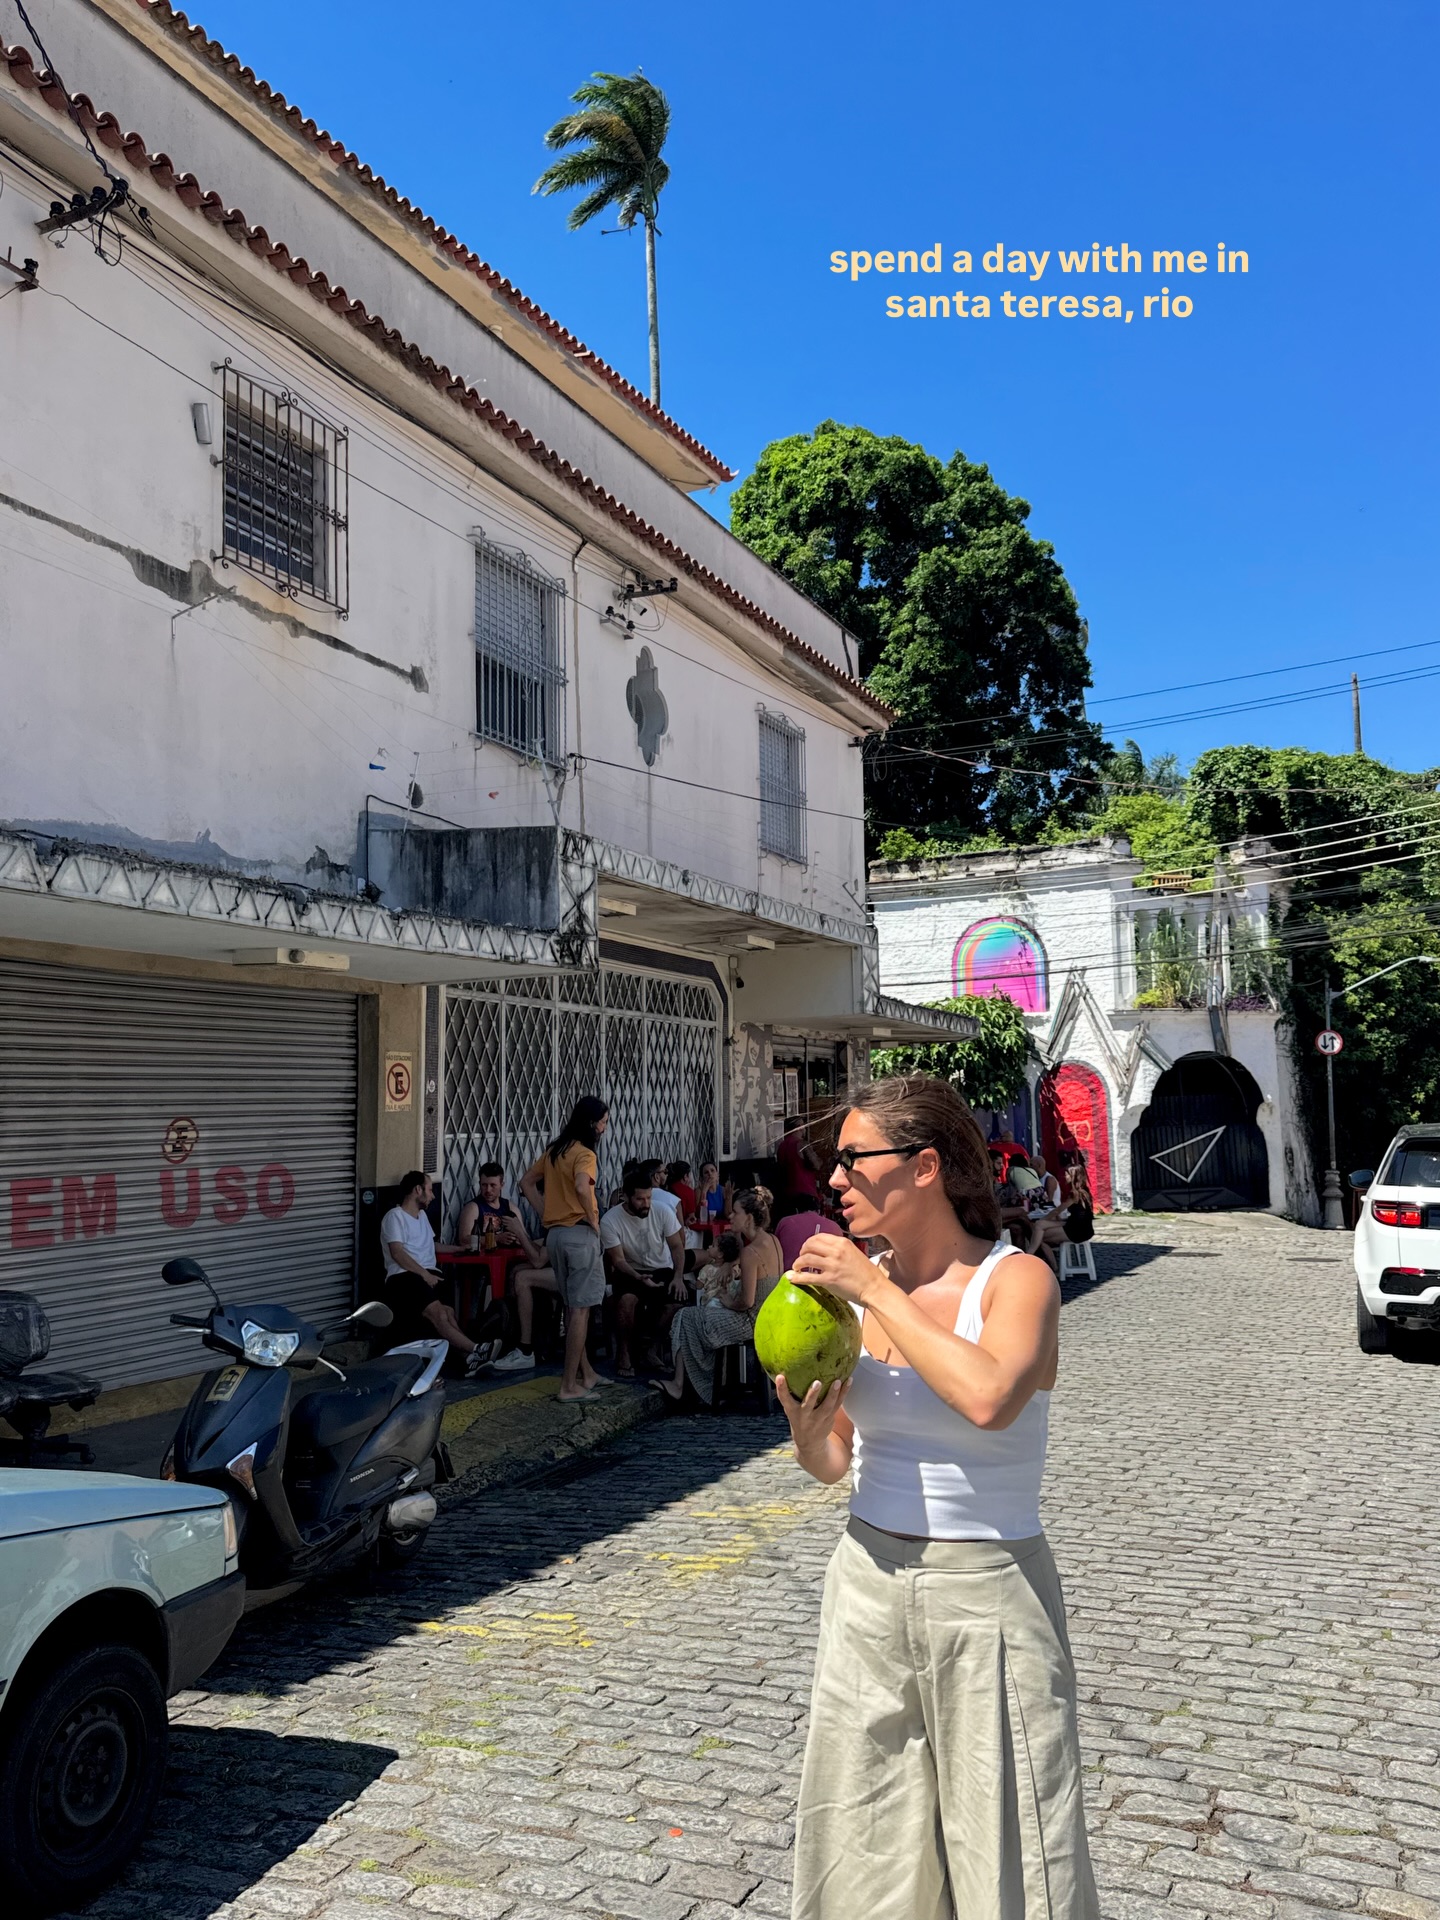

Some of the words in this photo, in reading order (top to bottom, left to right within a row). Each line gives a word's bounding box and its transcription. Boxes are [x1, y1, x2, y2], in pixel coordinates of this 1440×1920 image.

[10, 1173, 118, 1249] EM
[159, 1163, 295, 1228] USO
[350, 1468, 375, 1483] HONDA
